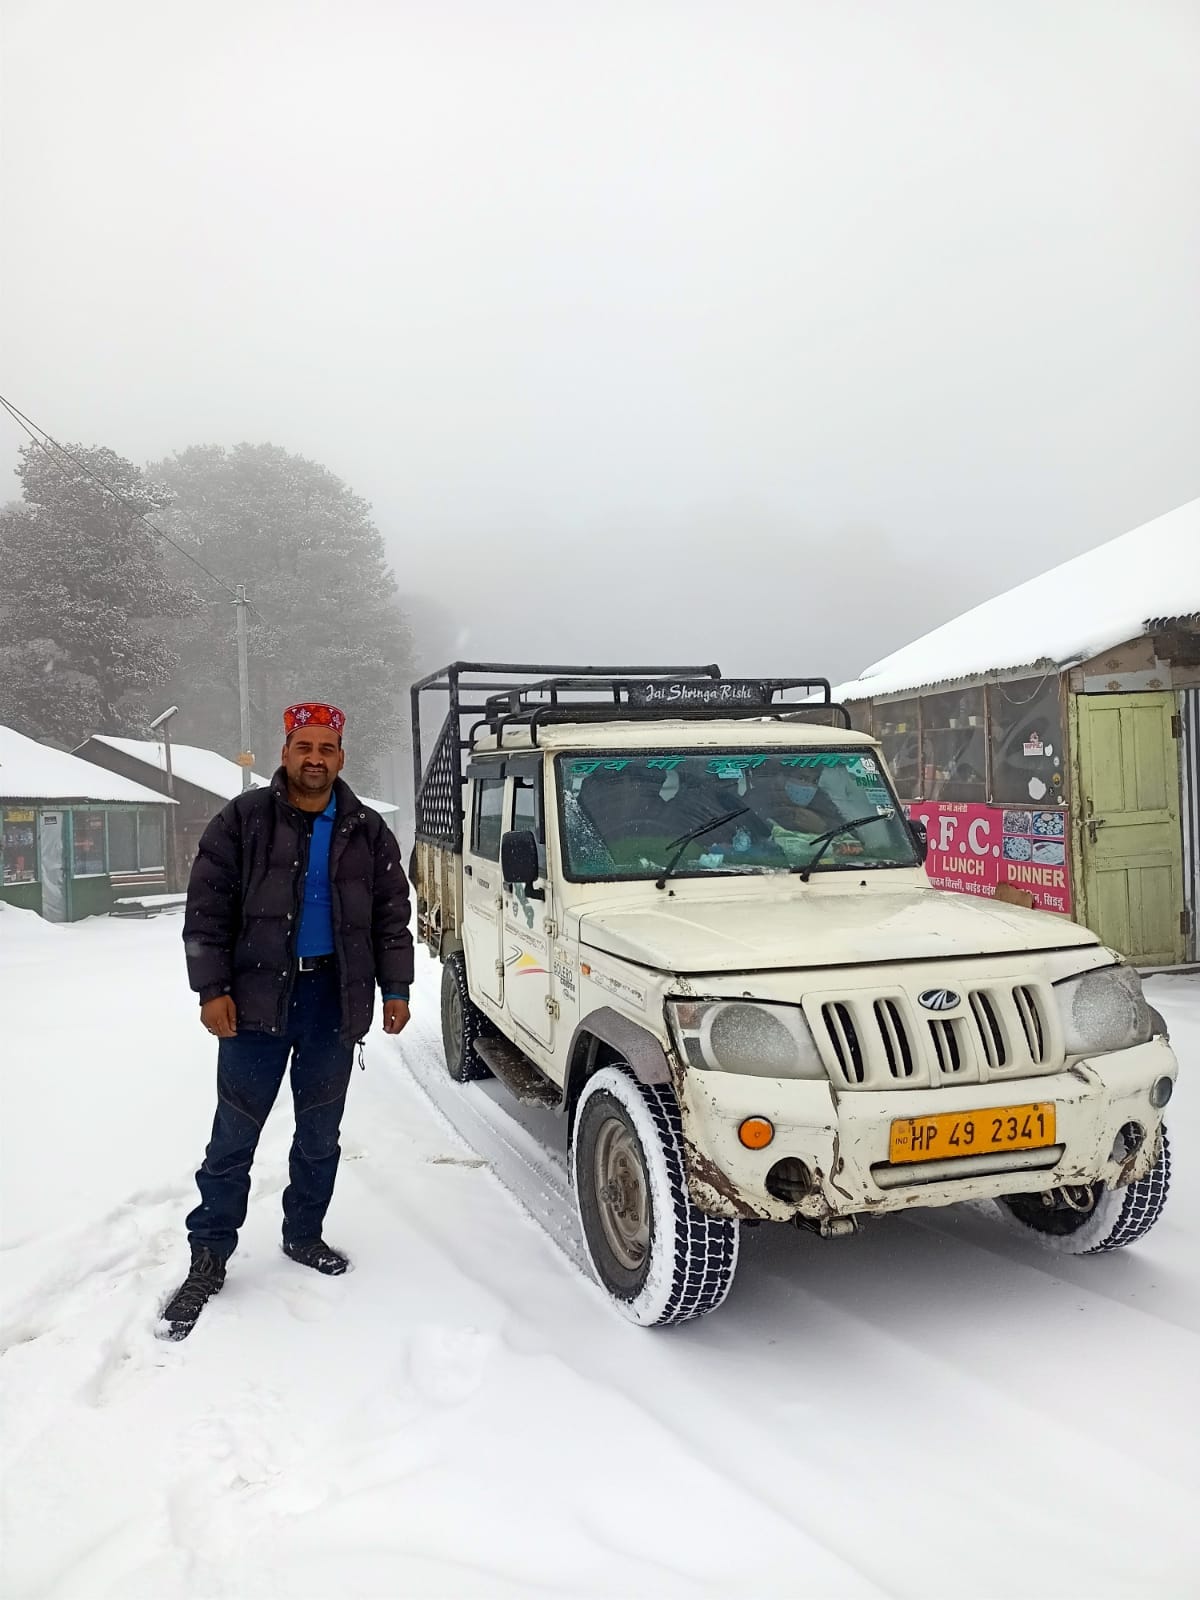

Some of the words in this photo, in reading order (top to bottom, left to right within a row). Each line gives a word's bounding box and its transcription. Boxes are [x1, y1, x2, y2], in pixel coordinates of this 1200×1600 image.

[646, 684, 665, 702] Jai
[667, 684, 718, 702] Shringa
[719, 684, 752, 700] Rishi
[571, 758, 632, 774] जय
[942, 855, 985, 876] LUNCH
[1007, 863, 1066, 888] DINNER
[895, 1136, 908, 1145] IND
[911, 1125, 938, 1151] HP
[948, 1121, 975, 1147] 49
[991, 1113, 1045, 1143] 2341
